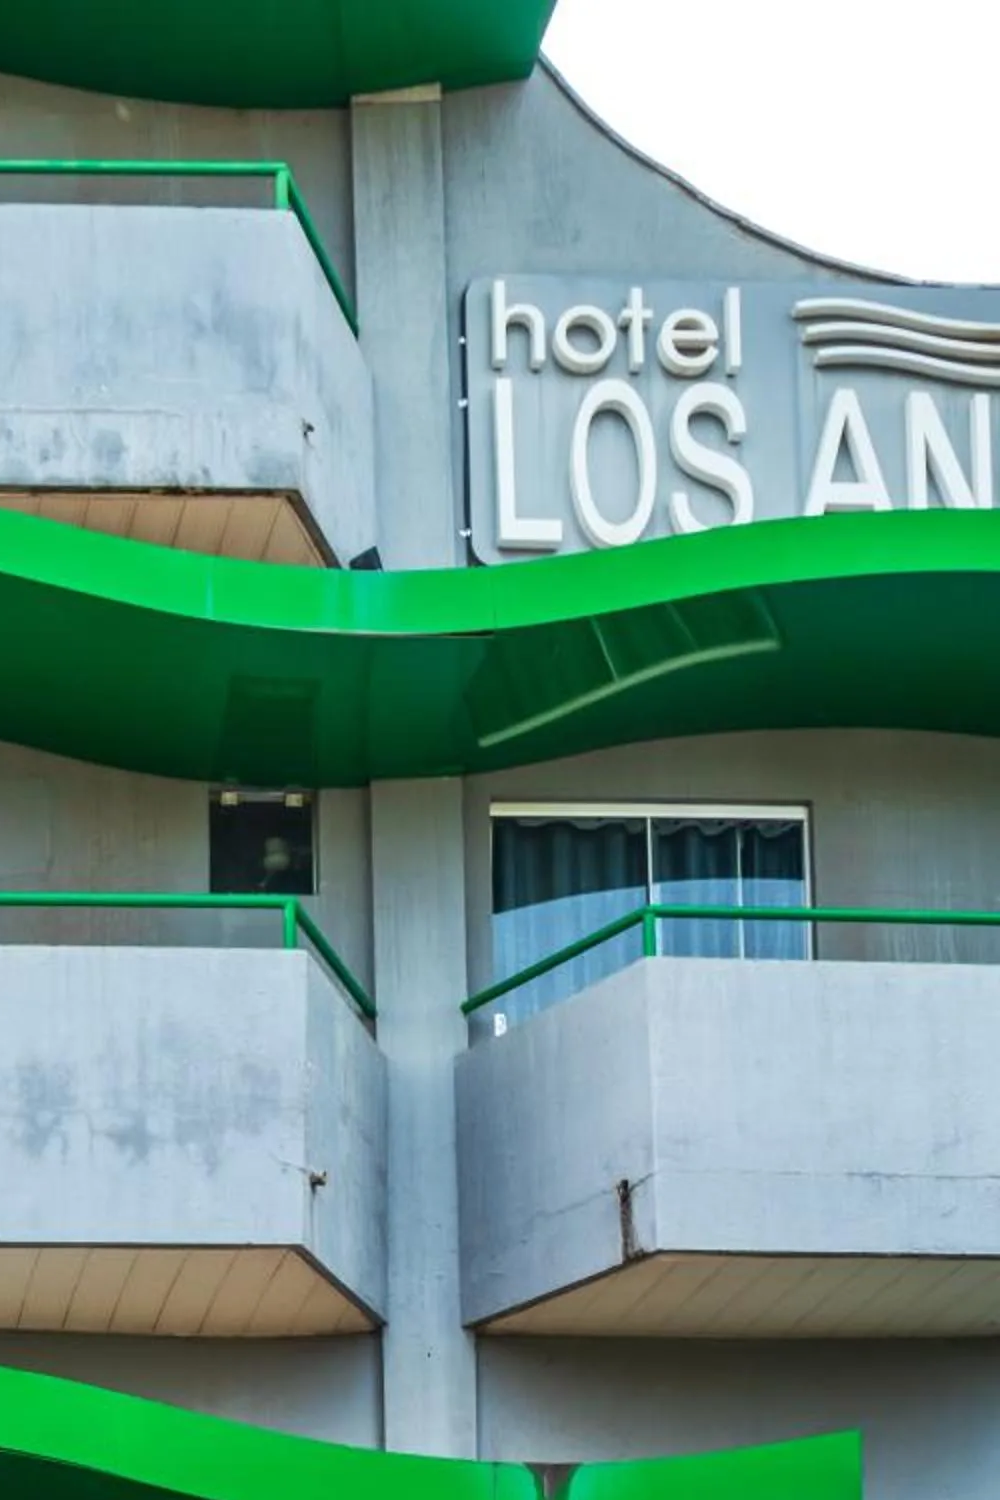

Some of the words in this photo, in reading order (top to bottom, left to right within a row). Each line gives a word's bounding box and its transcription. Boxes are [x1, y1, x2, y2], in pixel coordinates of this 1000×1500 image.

[491, 279, 741, 377] hotel
[494, 377, 754, 550] LOS
[804, 387, 992, 516] AN
